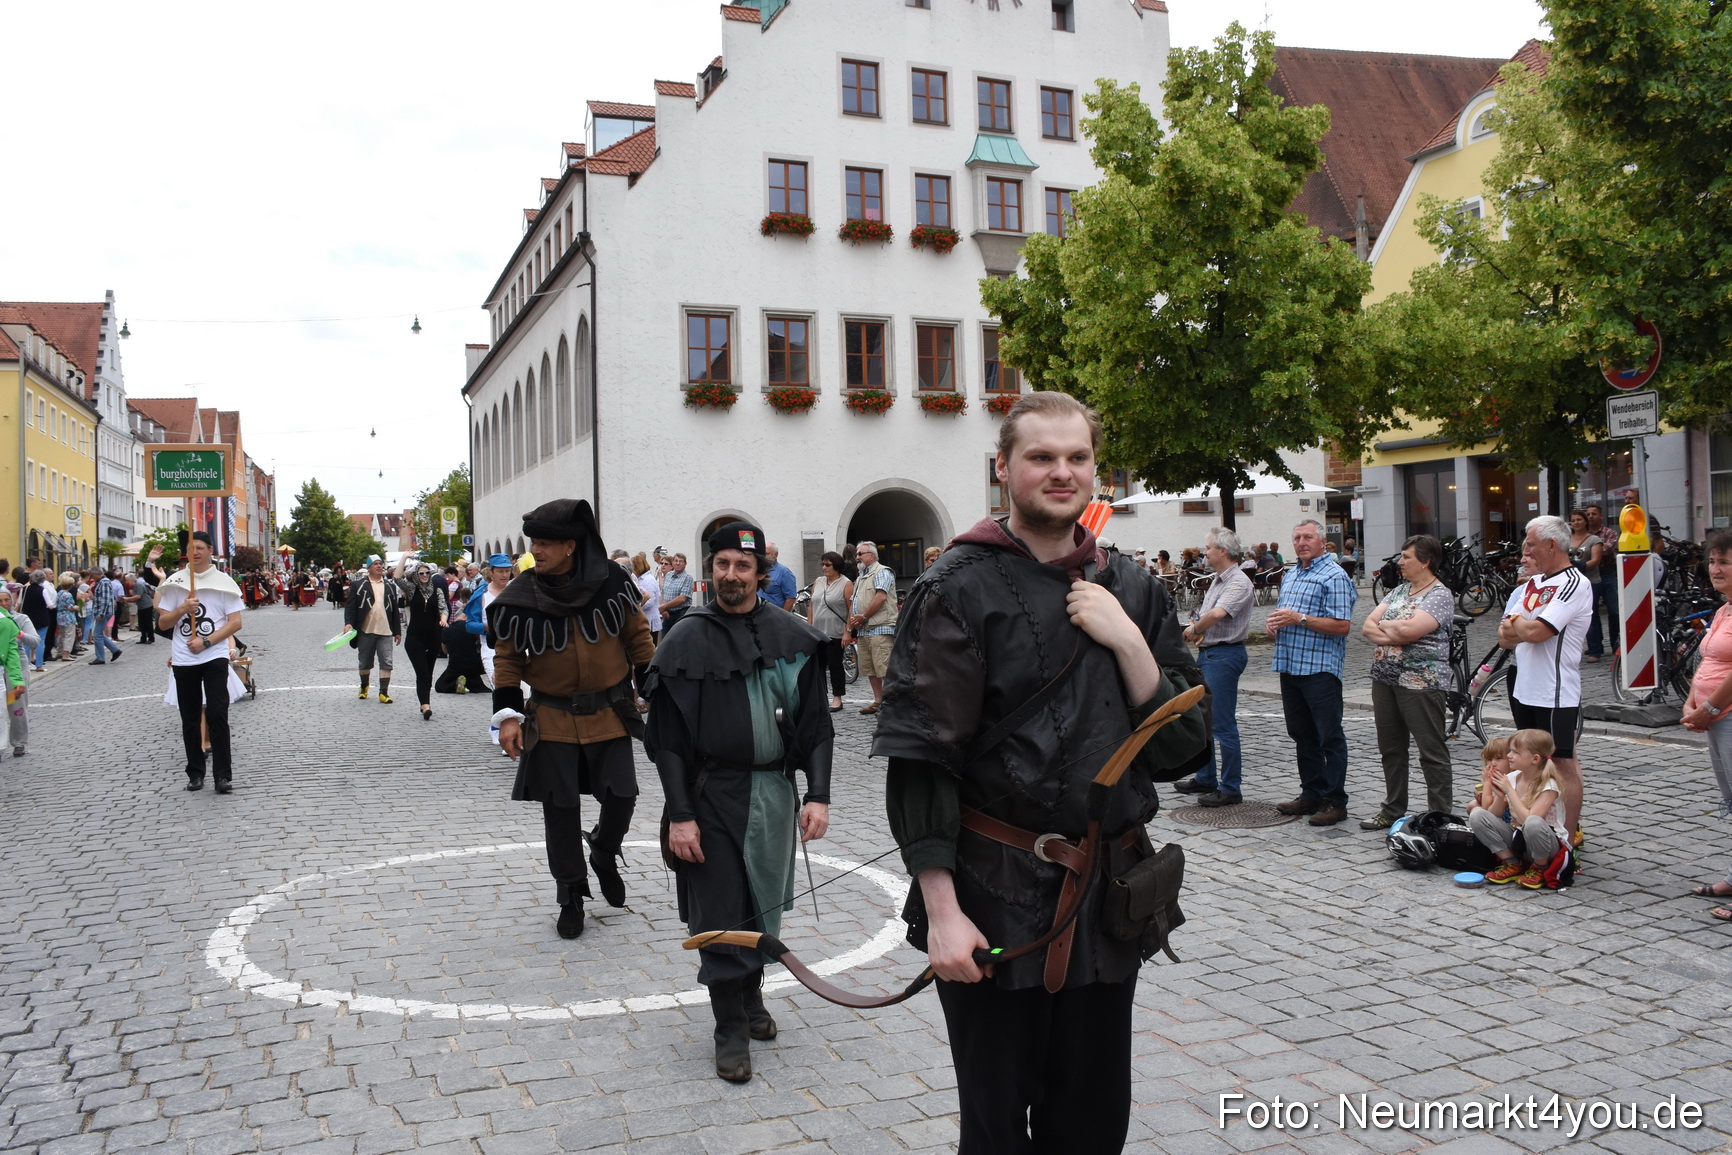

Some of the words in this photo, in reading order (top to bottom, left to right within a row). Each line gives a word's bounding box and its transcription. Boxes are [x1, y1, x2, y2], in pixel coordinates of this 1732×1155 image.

[1611, 400, 1654, 415] Wendebereich
[1619, 418, 1647, 429] freihalten
[160, 468, 218, 481] burghofspiele
